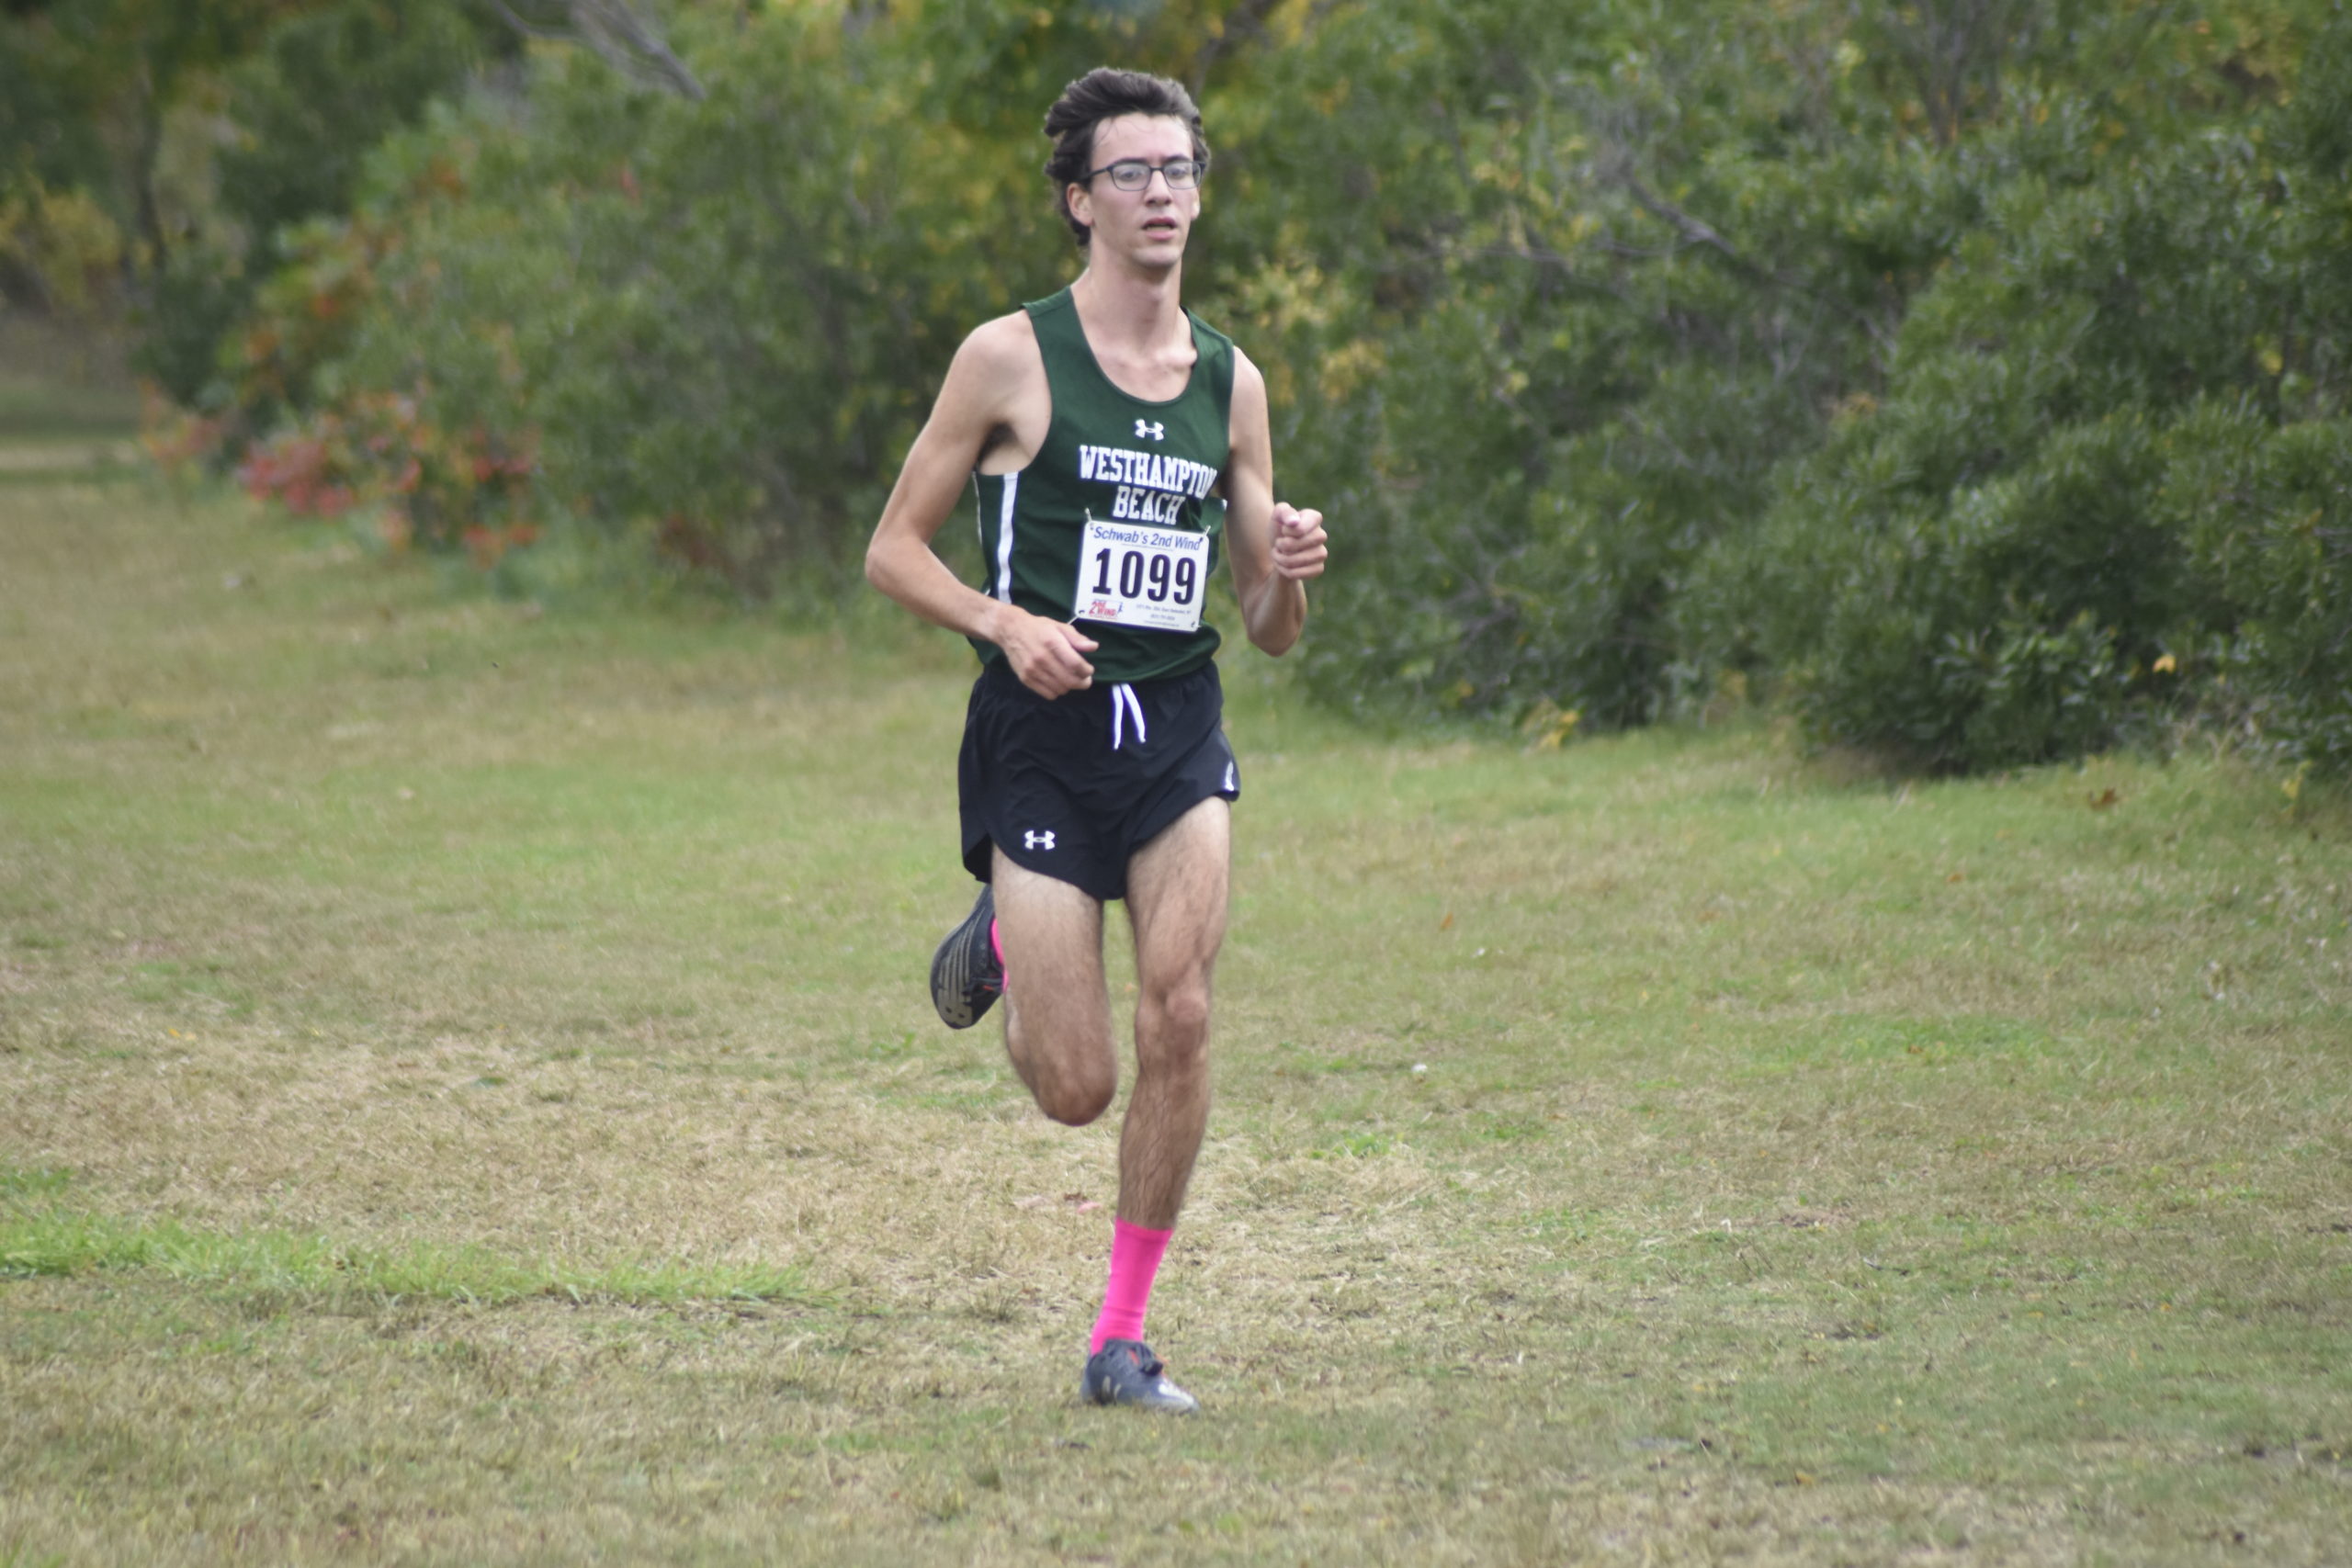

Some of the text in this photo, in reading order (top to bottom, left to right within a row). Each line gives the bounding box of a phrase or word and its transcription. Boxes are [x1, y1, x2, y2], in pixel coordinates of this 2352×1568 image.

[1112, 485, 1186, 525] BEACH
[1093, 525, 1148, 544] Schwab's
[1150, 533, 1172, 547] 2nd
[1174, 536, 1202, 550] Wind
[1092, 547, 1196, 605] 1099
